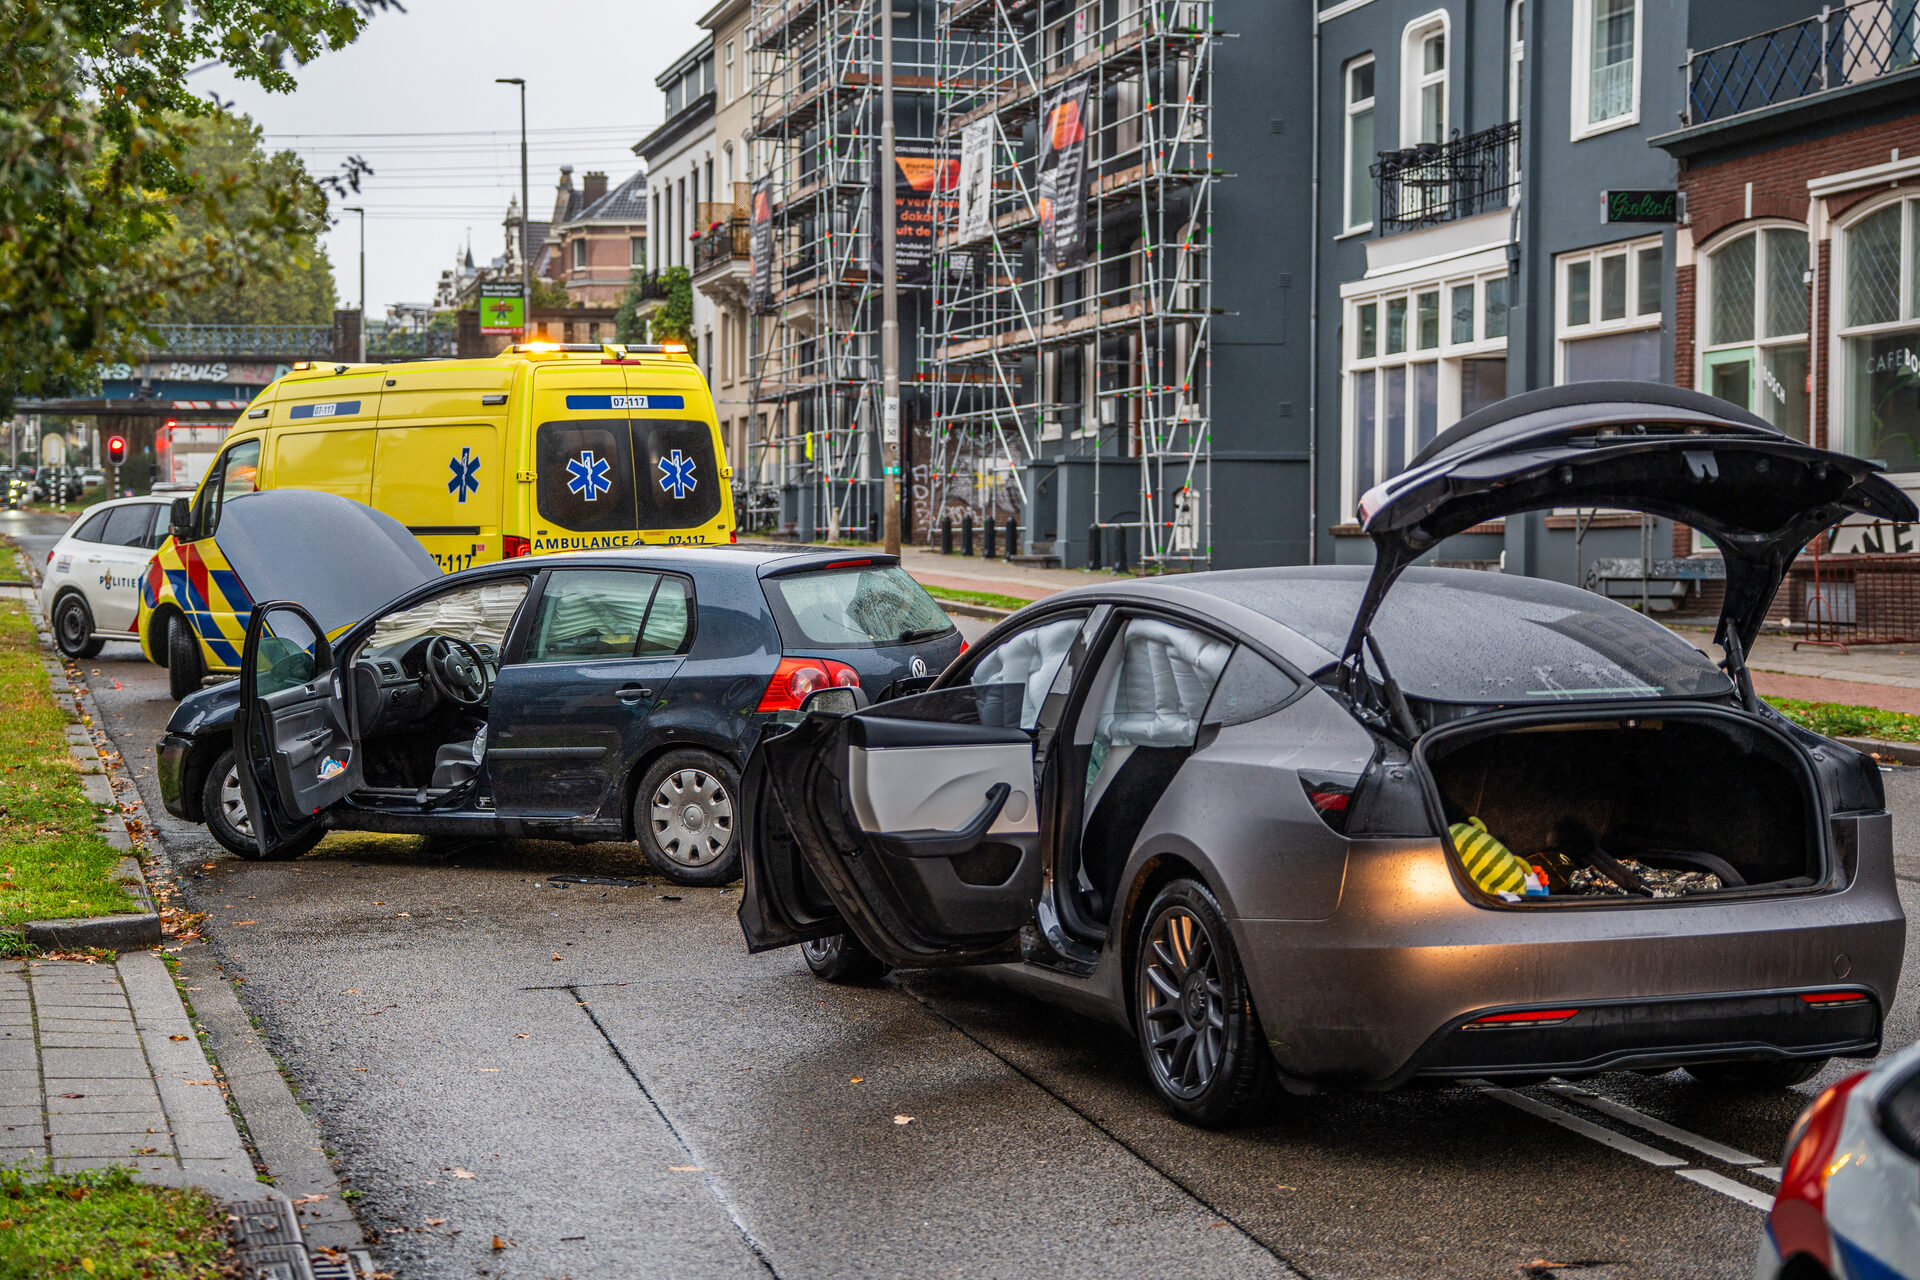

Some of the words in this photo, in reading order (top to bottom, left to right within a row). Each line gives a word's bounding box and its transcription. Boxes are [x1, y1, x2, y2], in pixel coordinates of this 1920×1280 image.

[1610, 192, 1675, 220] Grolsch
[1866, 349, 1902, 374] CAFE
[1763, 366, 1785, 404] BOSCH
[614, 397, 645, 407] 07-117
[314, 405, 335, 415] 07-117
[534, 535, 629, 550] AMBULANCE
[668, 535, 705, 545] 07-117
[430, 553, 472, 572] 7-117
[99, 575, 136, 590] POLITIE
